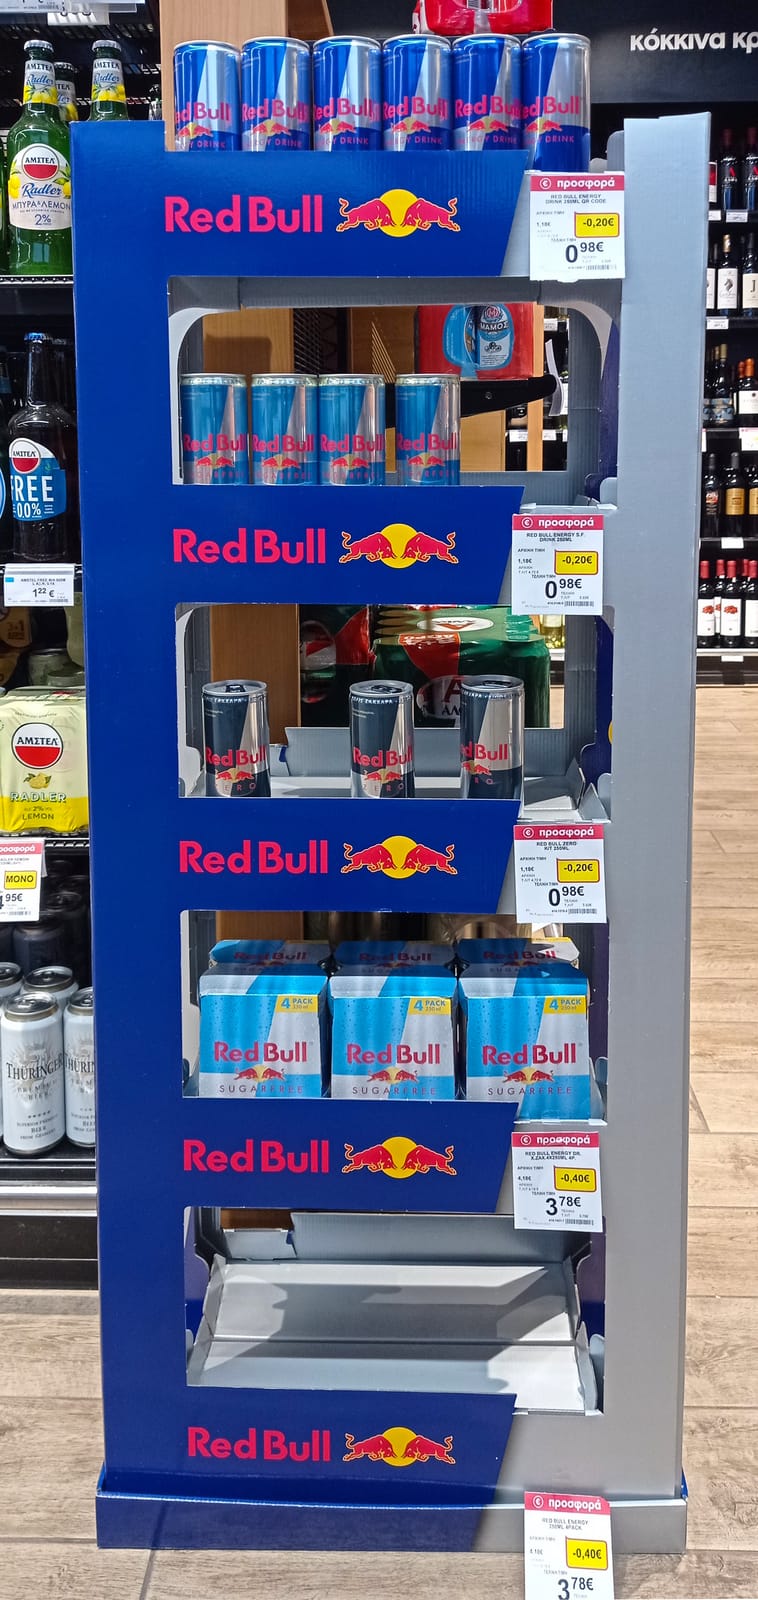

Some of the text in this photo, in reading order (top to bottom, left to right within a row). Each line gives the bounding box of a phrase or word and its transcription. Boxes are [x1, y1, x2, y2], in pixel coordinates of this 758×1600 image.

[630, 27, 726, 51] κόκκινα
[242, 98, 269, 122] Red
[337, 97, 373, 117] Bull
[455, 95, 487, 119] Red
[543, 96, 580, 114] Bull
[175, 102, 231, 123] ed Bull
[197, 141, 226, 149] DRINK
[339, 136, 369, 145] DRINK
[414, 135, 443, 145] DRINK
[545, 135, 575, 143] DRINK
[557, 177, 615, 190] προσφορά
[22, 182, 62, 198] Radler
[165, 194, 323, 233] Red Bull
[35, 214, 51, 226] 2%
[583, 218, 614, 228] -0,20€
[183, 433, 246, 451] Red Bull
[252, 433, 314, 452] Red Bull
[320, 433, 384, 452] Red Bull
[397, 432, 458, 450] Red Bull
[538, 517, 594, 528] προσφορά
[172, 528, 326, 564] Red Bull
[562, 556, 593, 565] -0,20€
[17, 737, 58, 745] ΑΜΣΤΕΛ
[205, 745, 267, 766] Red Bull
[353, 746, 383, 767] Red
[475, 743, 508, 760] Bull
[225, 782, 256, 791] ERO
[10, 791, 67, 803] RADLER
[539, 827, 594, 838] προσφορά
[0, 844, 35, 853] οσφορά
[179, 839, 329, 874] Red Bull
[563, 863, 593, 873] -0,20€
[272, 951, 307, 960] Bull
[397, 952, 432, 961] Bull
[280, 998, 291, 1009] 4
[413, 1000, 424, 1011] 4
[549, 999, 559, 1010] 4
[214, 1041, 307, 1063] Red Bull
[346, 1043, 441, 1064] Red Bull
[482, 1043, 577, 1065] Red Bull
[219, 1084, 303, 1093] SUGARFREE
[352, 1086, 436, 1095] SUGARFREE
[487, 1087, 572, 1096] SUGARFREE
[536, 1135, 590, 1146] προσφορά
[183, 1139, 329, 1173] Red Bull
[560, 1174, 590, 1183] -0,40€
[187, 1427, 331, 1462] Red Bull
[549, 1499, 601, 1511] προσφορά
[572, 1548, 602, 1560] -0,40€
